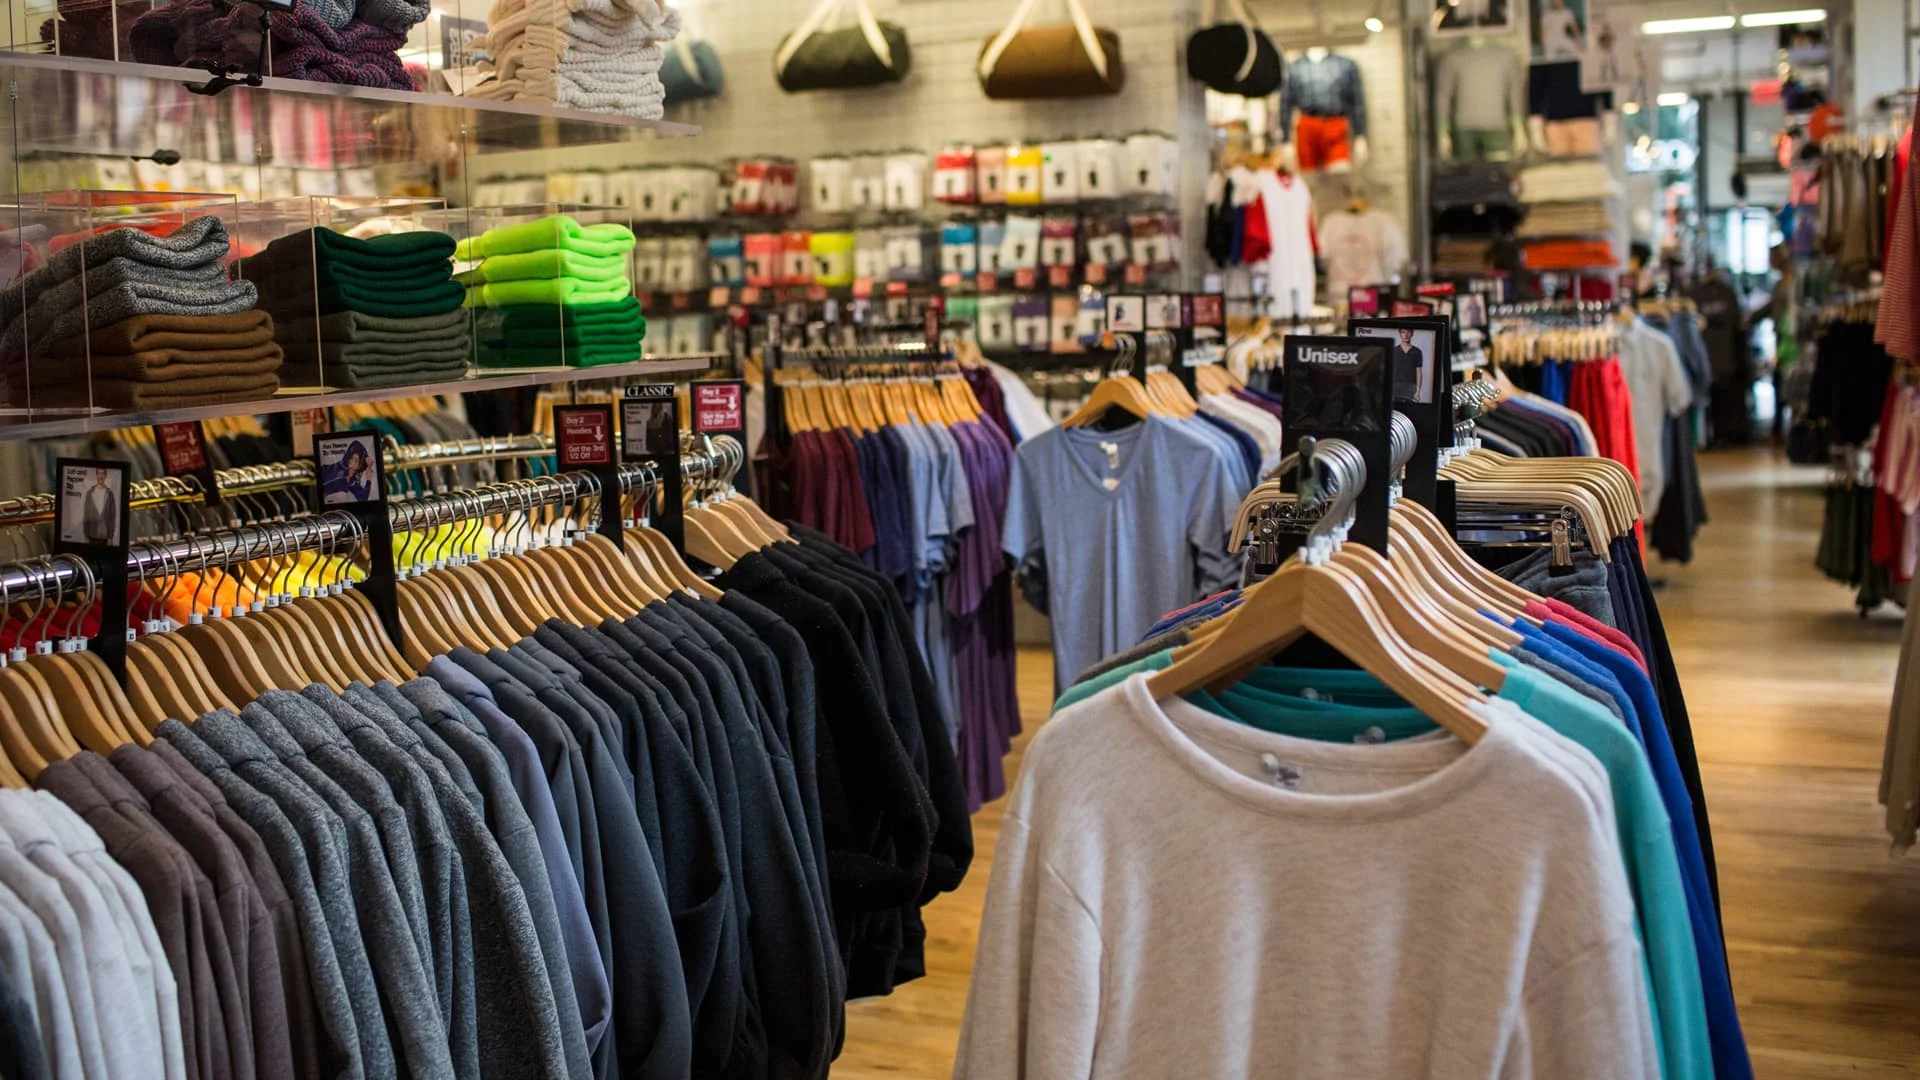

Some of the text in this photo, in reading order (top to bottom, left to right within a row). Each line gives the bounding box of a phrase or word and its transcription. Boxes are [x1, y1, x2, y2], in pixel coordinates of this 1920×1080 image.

[1298, 347, 1358, 364] Unisex
[627, 386, 672, 397] CLASSIC
[566, 416, 578, 424] Buy
